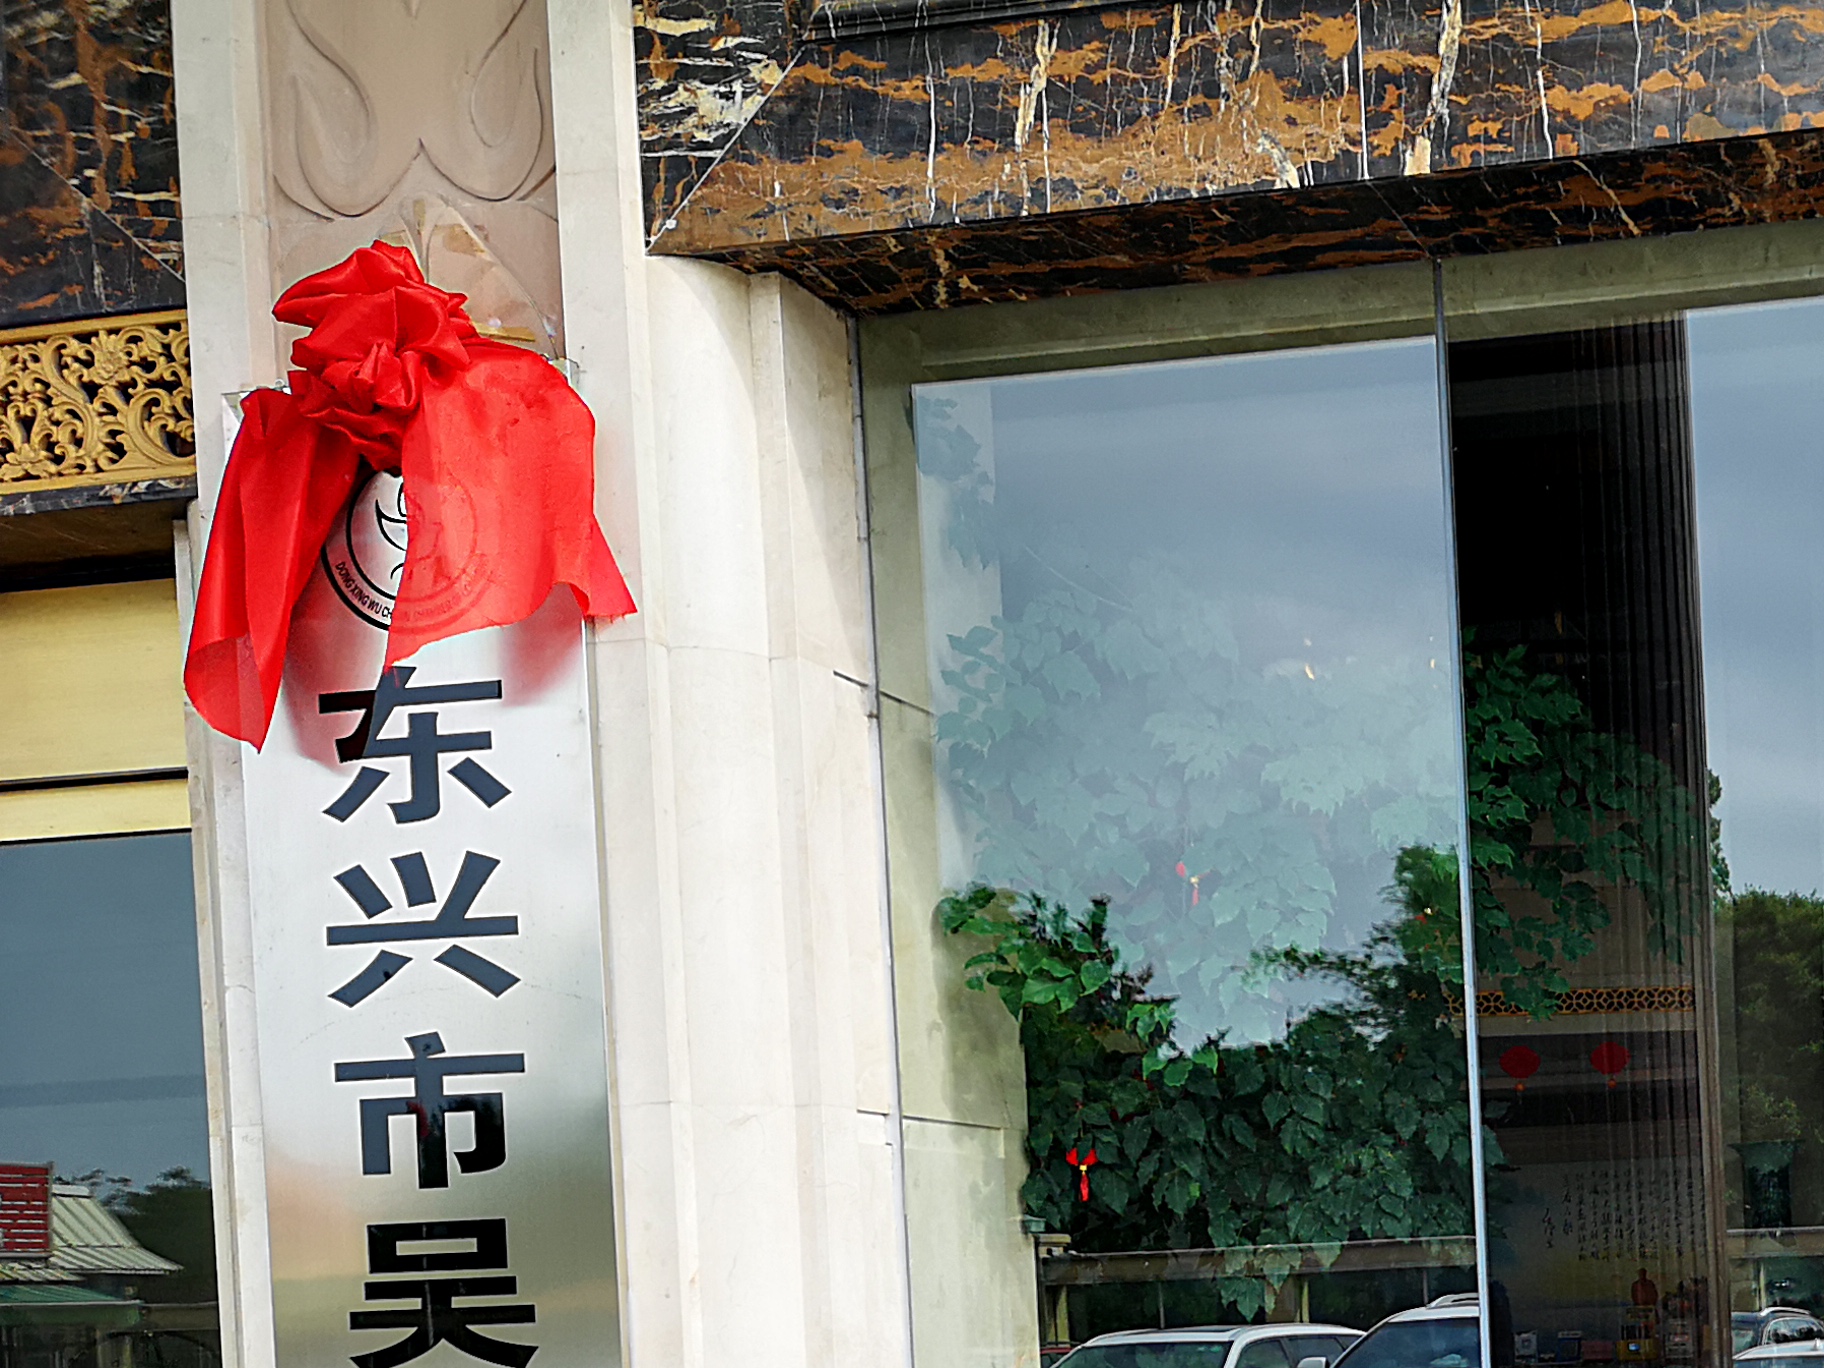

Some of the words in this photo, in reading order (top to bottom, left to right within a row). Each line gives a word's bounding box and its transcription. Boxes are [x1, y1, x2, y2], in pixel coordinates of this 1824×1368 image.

[335, 561, 352, 588] DONG
[350, 584, 369, 606] XING
[367, 599, 382, 615] WU
